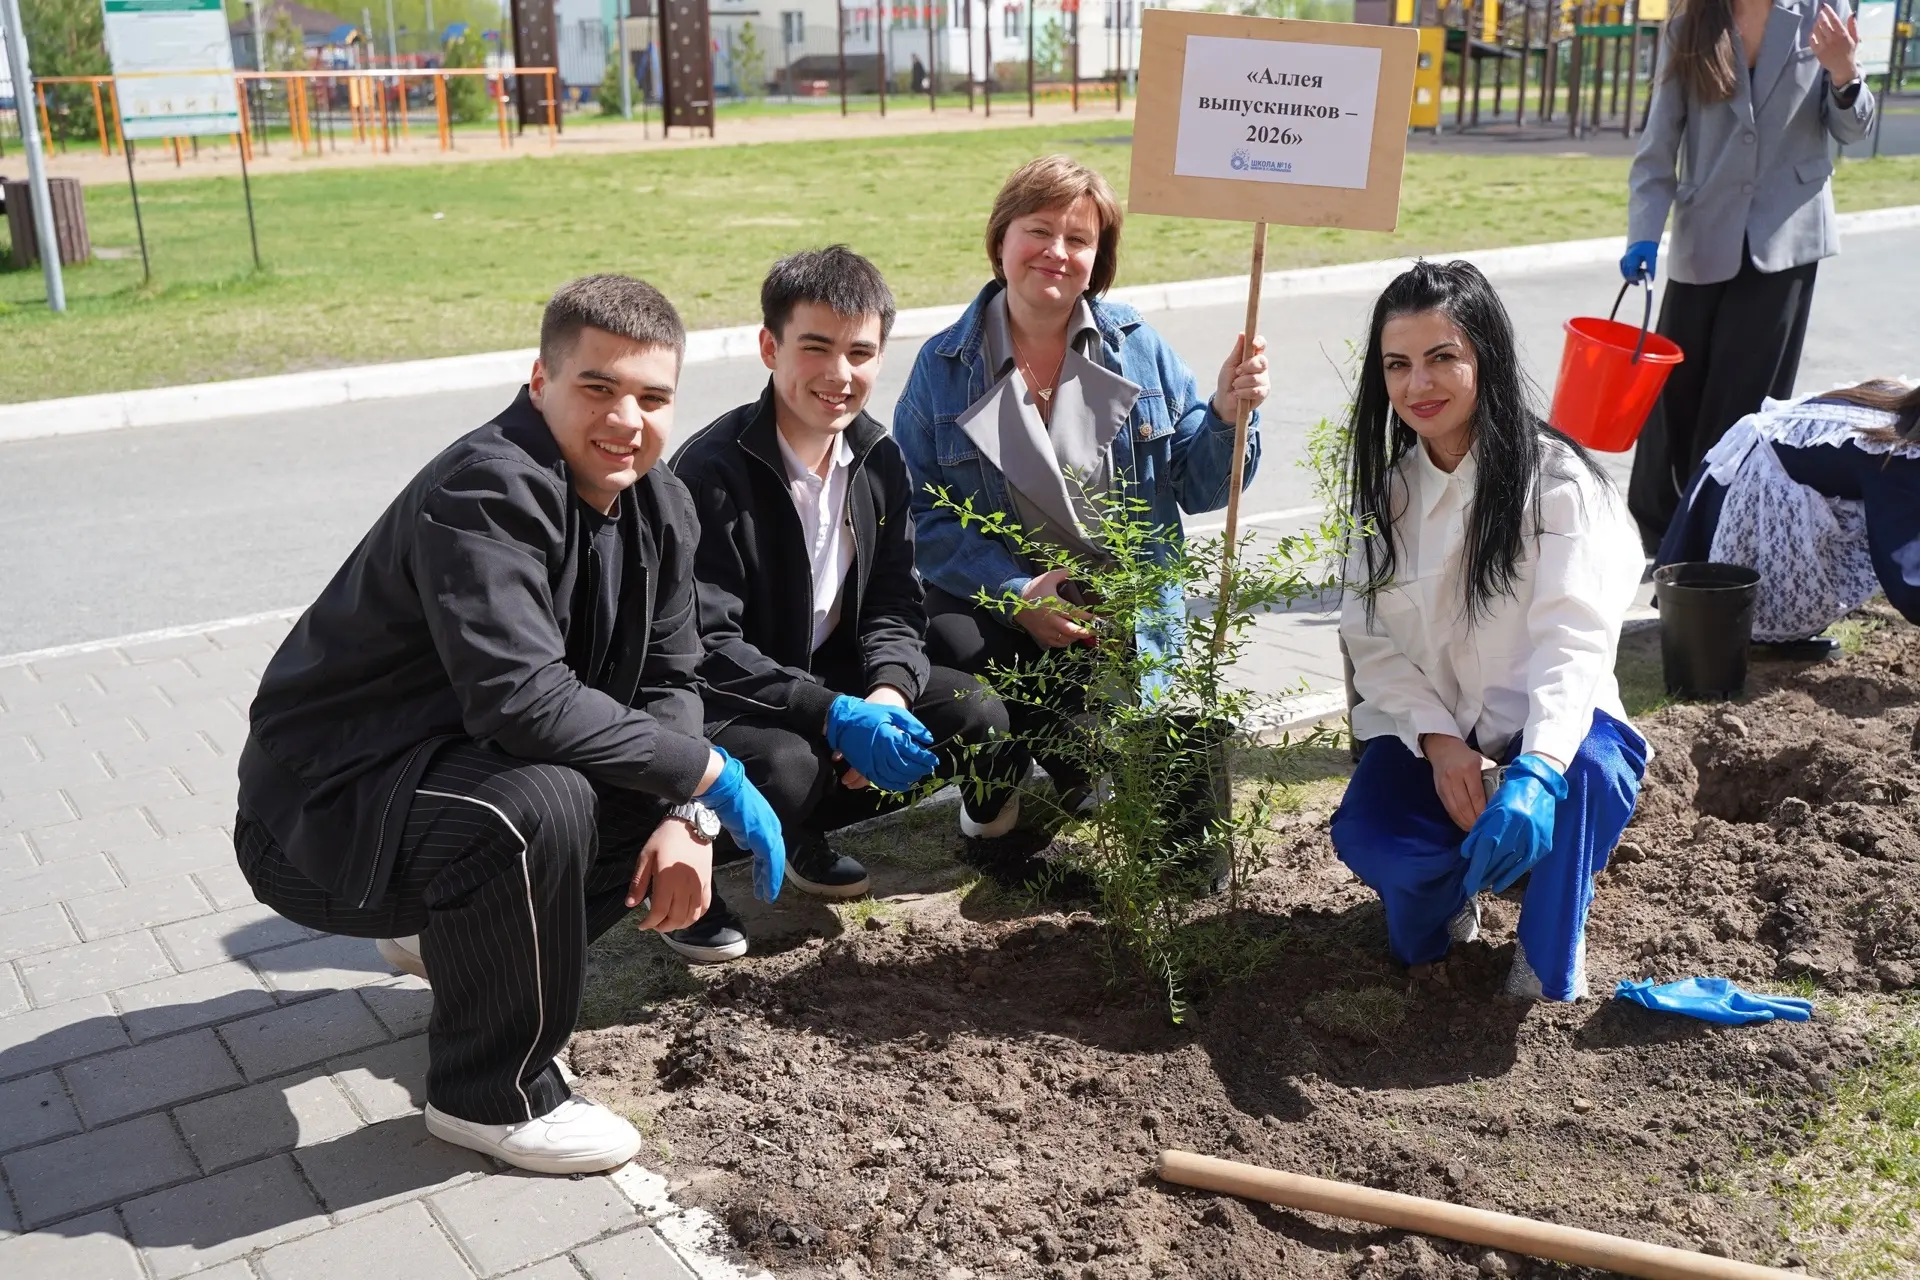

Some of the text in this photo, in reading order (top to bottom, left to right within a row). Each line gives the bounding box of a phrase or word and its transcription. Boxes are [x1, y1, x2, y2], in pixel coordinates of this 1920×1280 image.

[1246, 67, 1323, 88] «Аллея
[1198, 96, 1340, 119] выпускников
[1245, 125, 1303, 145] 2026»
[1251, 160, 1275, 168] ШКОЛА
